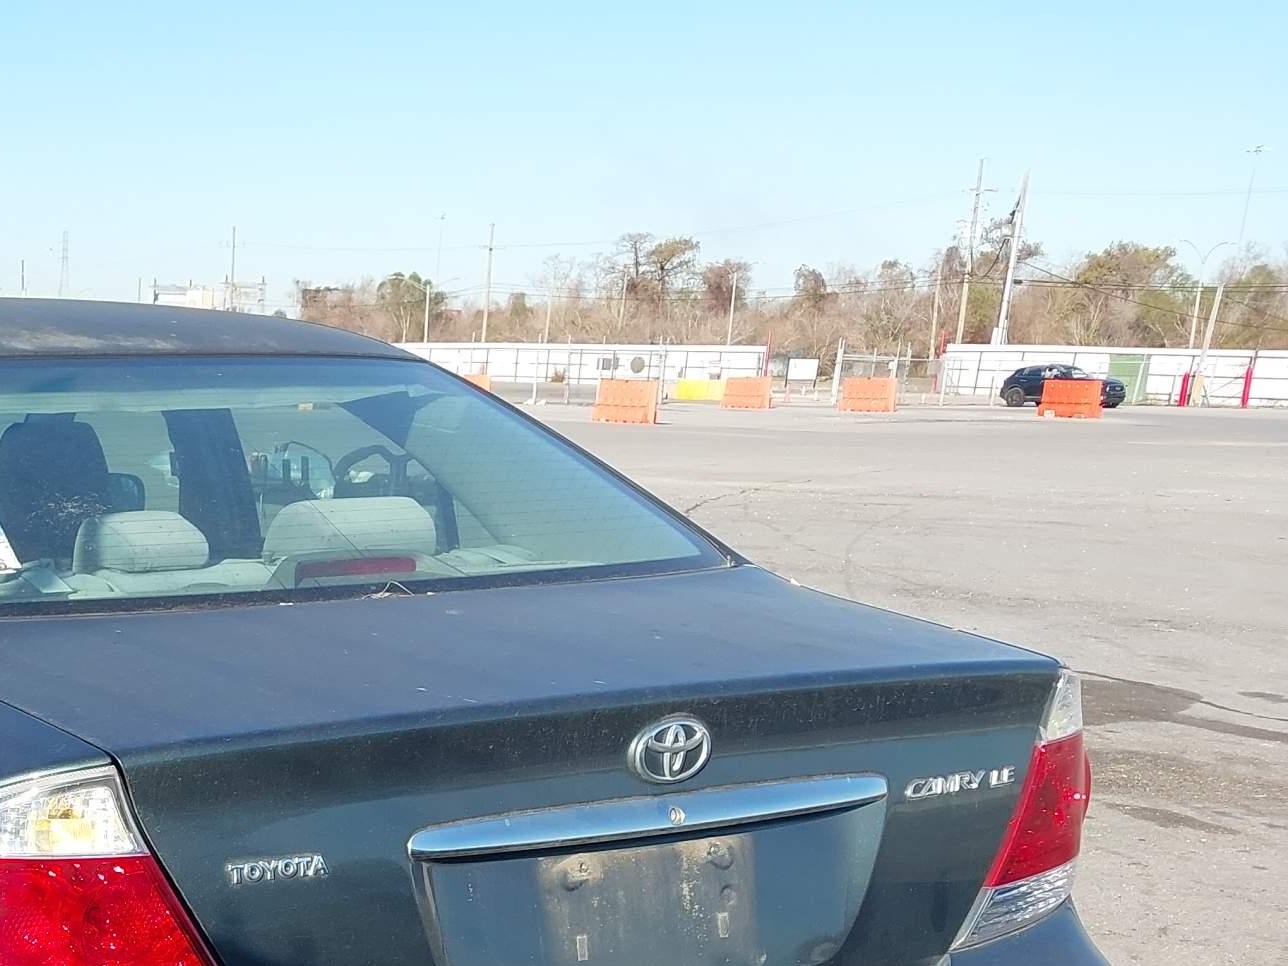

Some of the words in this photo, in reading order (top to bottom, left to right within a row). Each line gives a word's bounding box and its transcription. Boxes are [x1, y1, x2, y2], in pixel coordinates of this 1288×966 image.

[904, 769, 986, 800] CAMRY
[989, 765, 1016, 788] LE
[225, 855, 329, 885] TOYOTA
